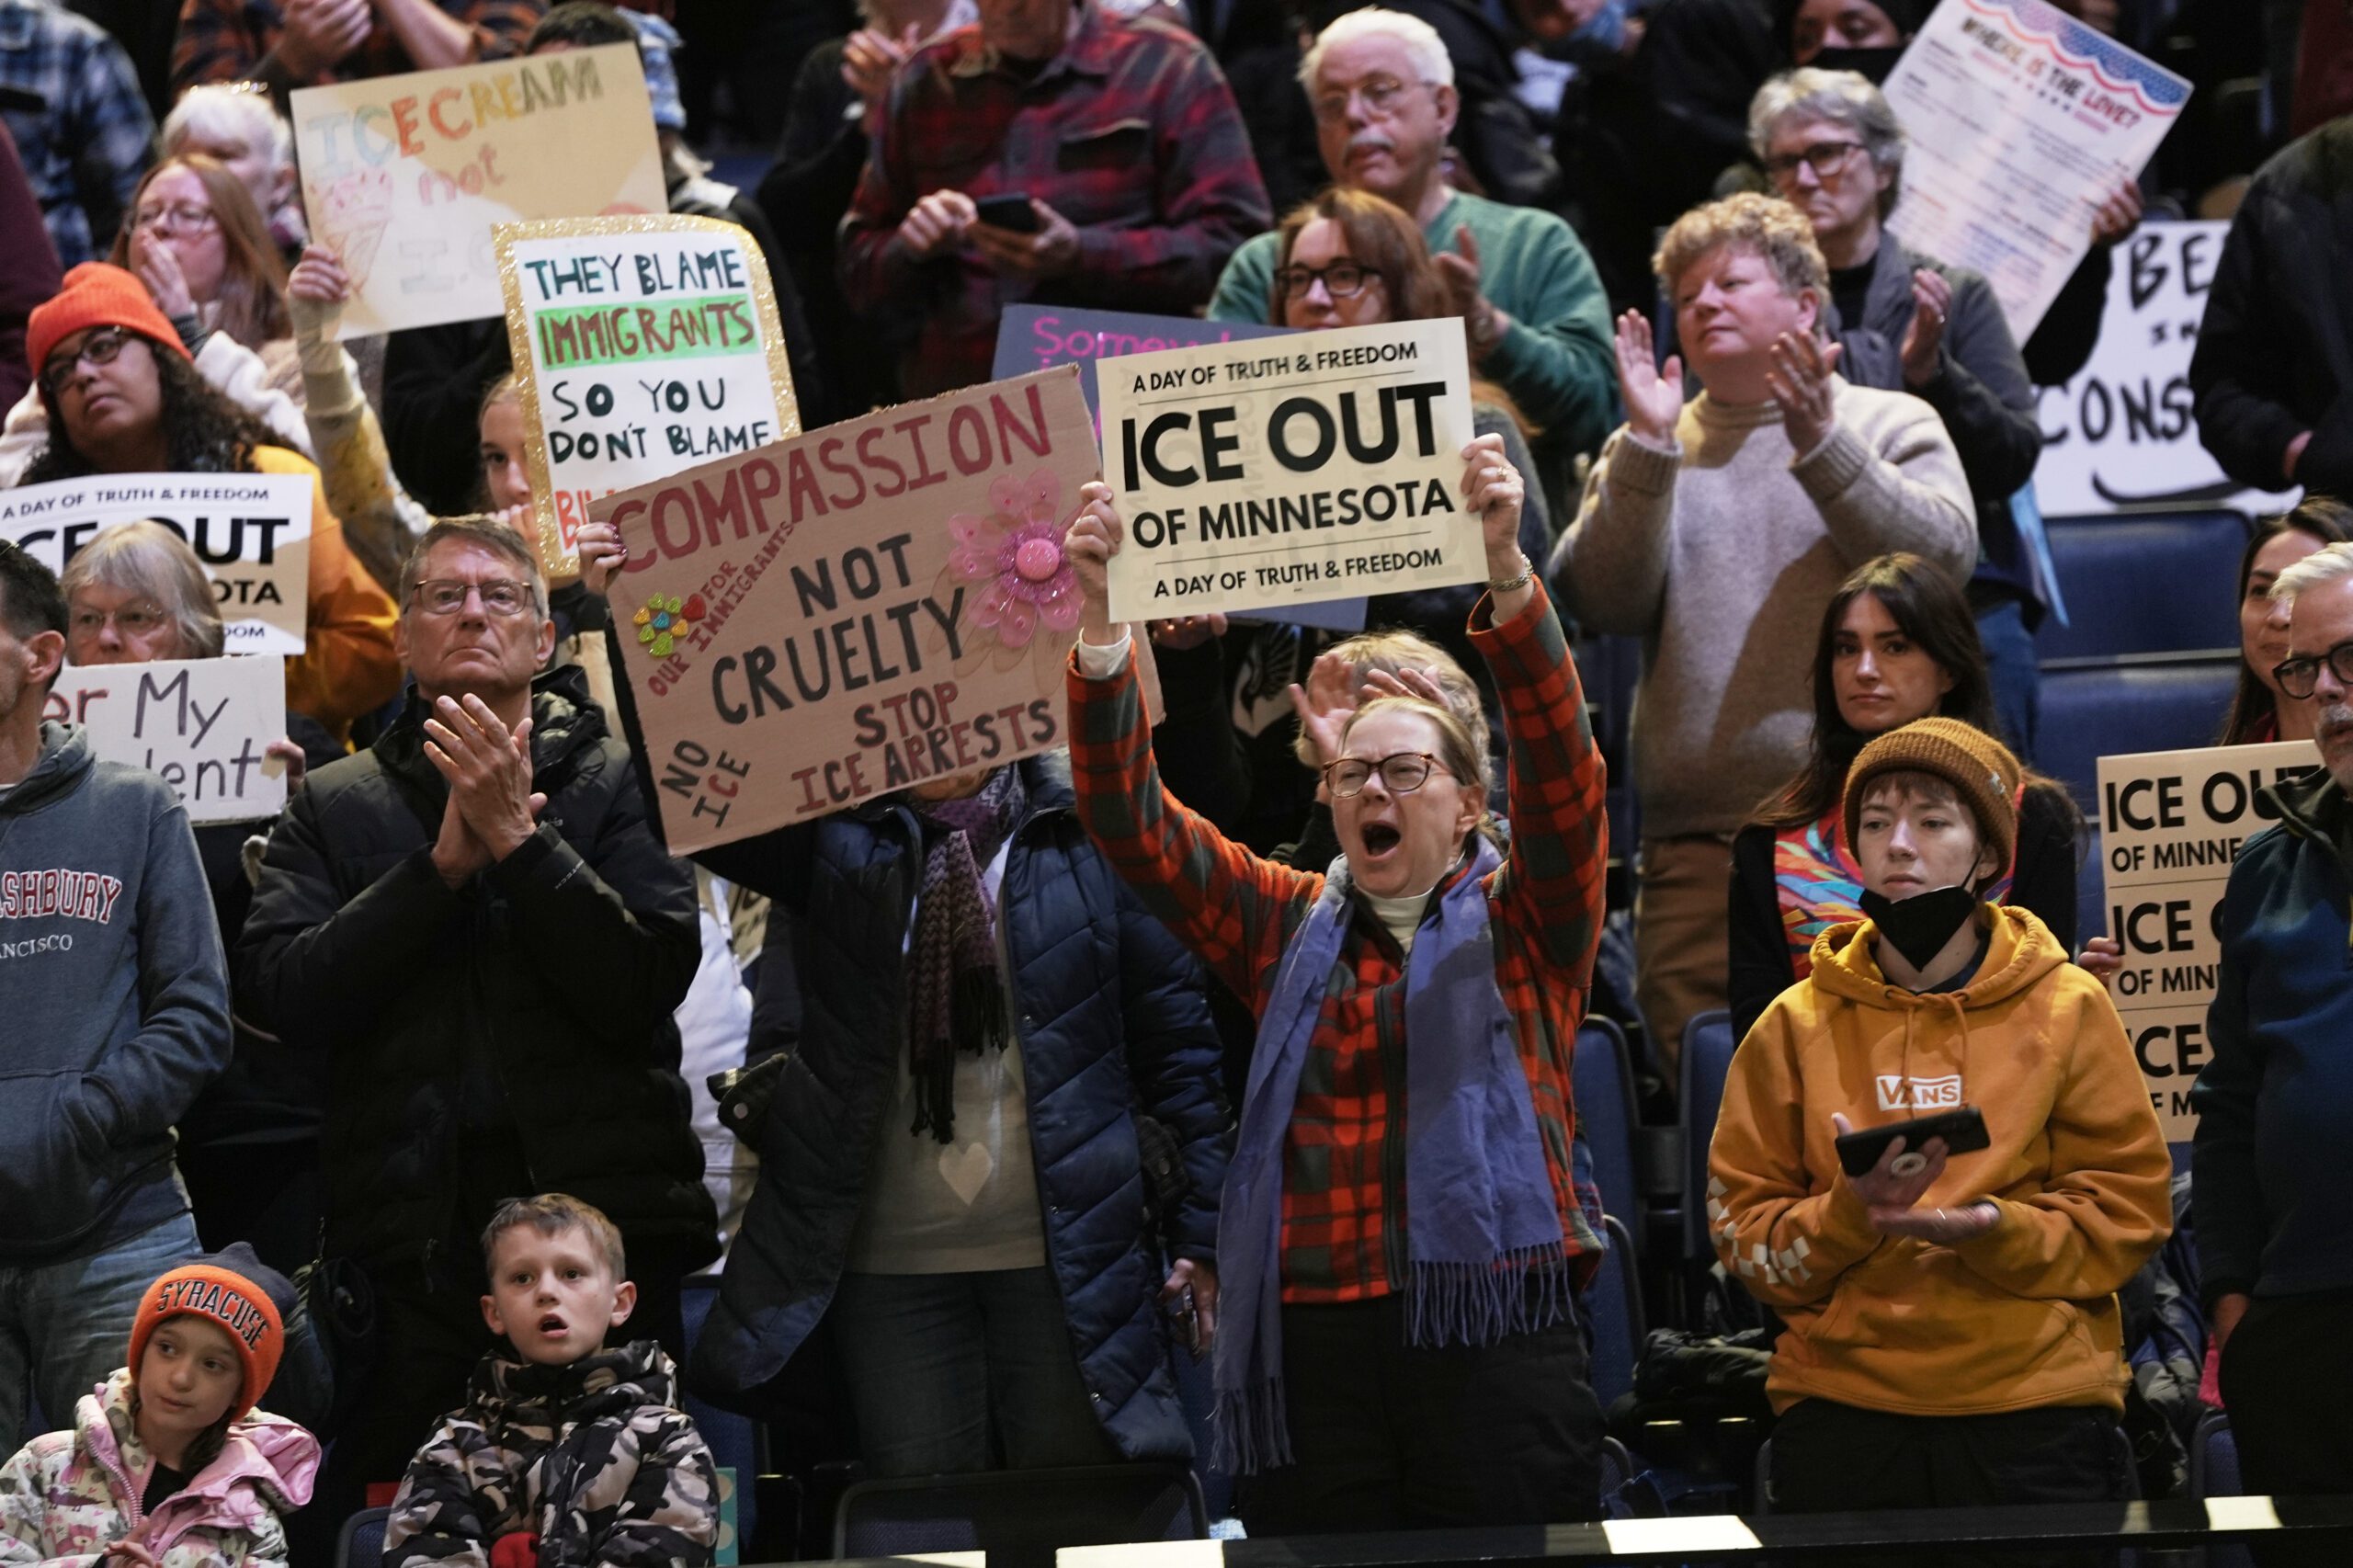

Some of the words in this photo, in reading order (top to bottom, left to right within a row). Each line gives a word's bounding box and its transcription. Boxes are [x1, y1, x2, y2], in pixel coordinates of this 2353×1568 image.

[1961, 17, 2023, 64] WHERE
[2026, 57, 2046, 77] IS
[2047, 66, 2086, 97] THE
[2081, 88, 2142, 129] LOVE?
[418, 142, 506, 206] not
[525, 254, 622, 301] THEY
[634, 249, 745, 295] BLAME
[539, 301, 755, 365] IMMIGRANTS
[1133, 375, 1146, 392] A
[1150, 369, 1187, 391] DAY
[1191, 366, 1216, 384] OF
[1225, 356, 1290, 381] TRUTH
[1296, 354, 1312, 372] &
[1316, 341, 1417, 370] FREEDOM
[551, 381, 614, 423] SO
[639, 378, 725, 413] YOU
[549, 423, 646, 463] DON'T
[1122, 405, 1244, 492] ICE
[1267, 381, 1447, 472] OUT
[2, 506, 16, 520] A
[20, 498, 56, 517] DAY
[61, 492, 85, 509] OF
[96, 488, 154, 503] TRUTH
[160, 488, 174, 500] &
[180, 488, 269, 501] FREEDOM
[609, 383, 1052, 574] COMPASSION
[147, 517, 290, 566] UT
[1132, 508, 1187, 549] OF
[1199, 477, 1455, 542] MINNESOTA
[700, 561, 739, 600] FOR
[790, 532, 912, 619] NOT
[1154, 580, 1170, 598] A
[1175, 574, 1216, 597] DAY
[1220, 571, 1247, 590] OF
[1255, 562, 1319, 587] TRUTH
[1325, 560, 1342, 579] &
[1345, 548, 1443, 576] FREEDOM
[647, 651, 691, 697] OUR
[687, 520, 795, 653] IMMIGRANTS
[711, 586, 965, 726] CRUELTY
[133, 668, 229, 749] My
[853, 680, 959, 748] STOP
[660, 739, 710, 799] NO
[791, 751, 872, 814] ICE
[884, 698, 1056, 789] ARRESTS
[691, 750, 751, 830] ICE
[2106, 776, 2185, 833] ICE
[2111, 846, 2145, 872] OF
[0, 869, 122, 925] SHBURY
[2112, 900, 2194, 956] ICE
[2118, 969, 2154, 995] OF
[2127, 1023, 2205, 1077] CE
[1878, 1078, 1959, 1106] VANS
[157, 1278, 270, 1350] SYRACUSE
